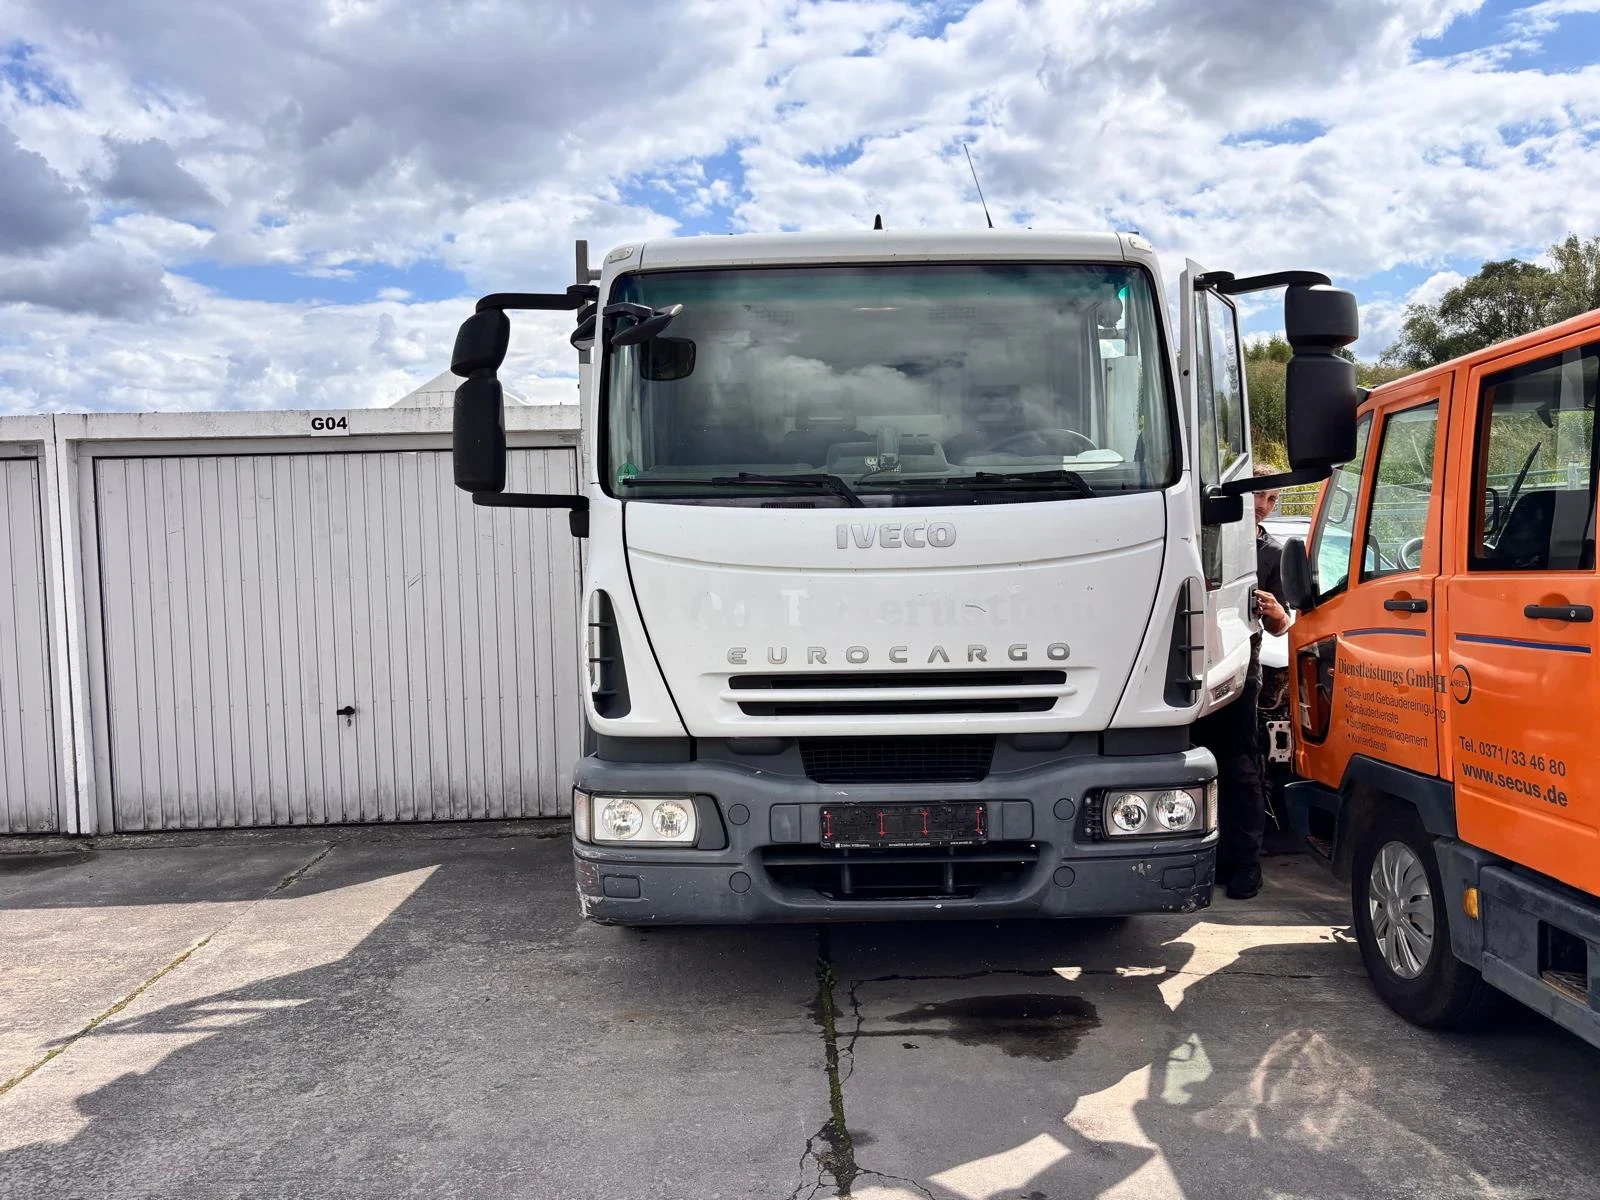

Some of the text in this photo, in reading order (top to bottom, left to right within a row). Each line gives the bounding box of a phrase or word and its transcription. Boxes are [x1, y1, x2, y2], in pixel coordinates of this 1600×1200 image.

[311, 416, 348, 431] G04
[836, 521, 957, 550] IVECO
[727, 642, 1071, 665] EUROCARGO
[1338, 657, 1448, 694] Dienstleistungs GmbH
[1348, 700, 1399, 725] Gebäudedienste
[1362, 689, 1375, 703] und
[1375, 691, 1446, 723] Gebäudereinigung
[1459, 735, 1477, 753] Tel.
[1511, 749, 1526, 767] 33
[1529, 754, 1546, 772] 46
[1549, 759, 1566, 777] 80
[1461, 762, 1568, 807] www.secus.de
